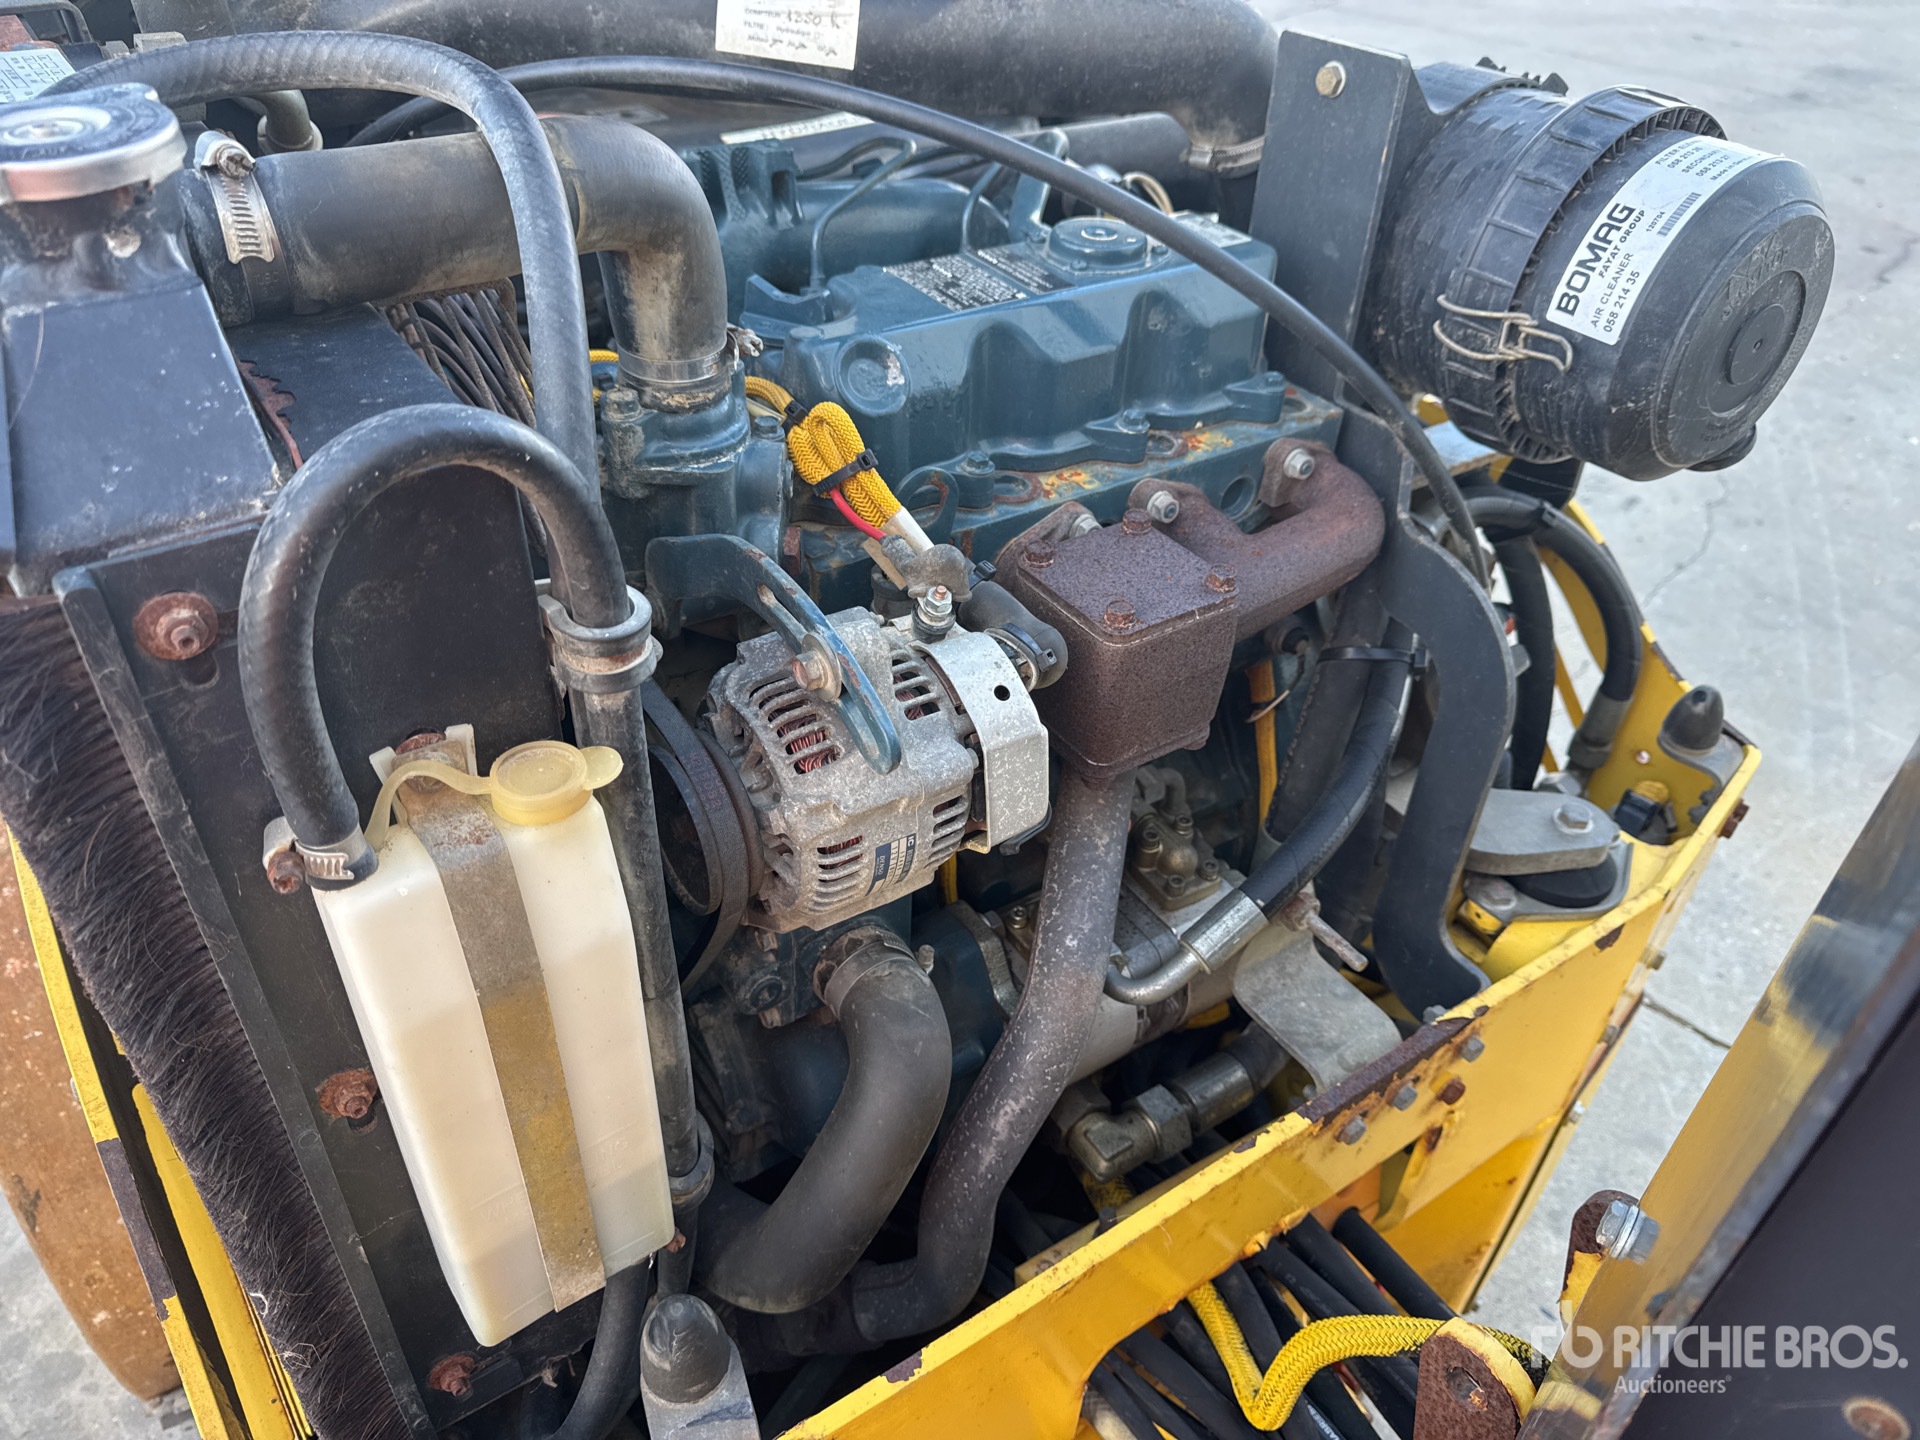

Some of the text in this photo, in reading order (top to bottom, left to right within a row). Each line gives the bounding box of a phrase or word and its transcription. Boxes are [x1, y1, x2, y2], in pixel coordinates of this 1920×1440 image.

[1555, 203, 1637, 317] BOMAG
[1598, 209, 1645, 279] FAYAT GROUP
[1590, 252, 1634, 328] AIR CLEANER
[1603, 270, 1640, 333] 058 214 35
